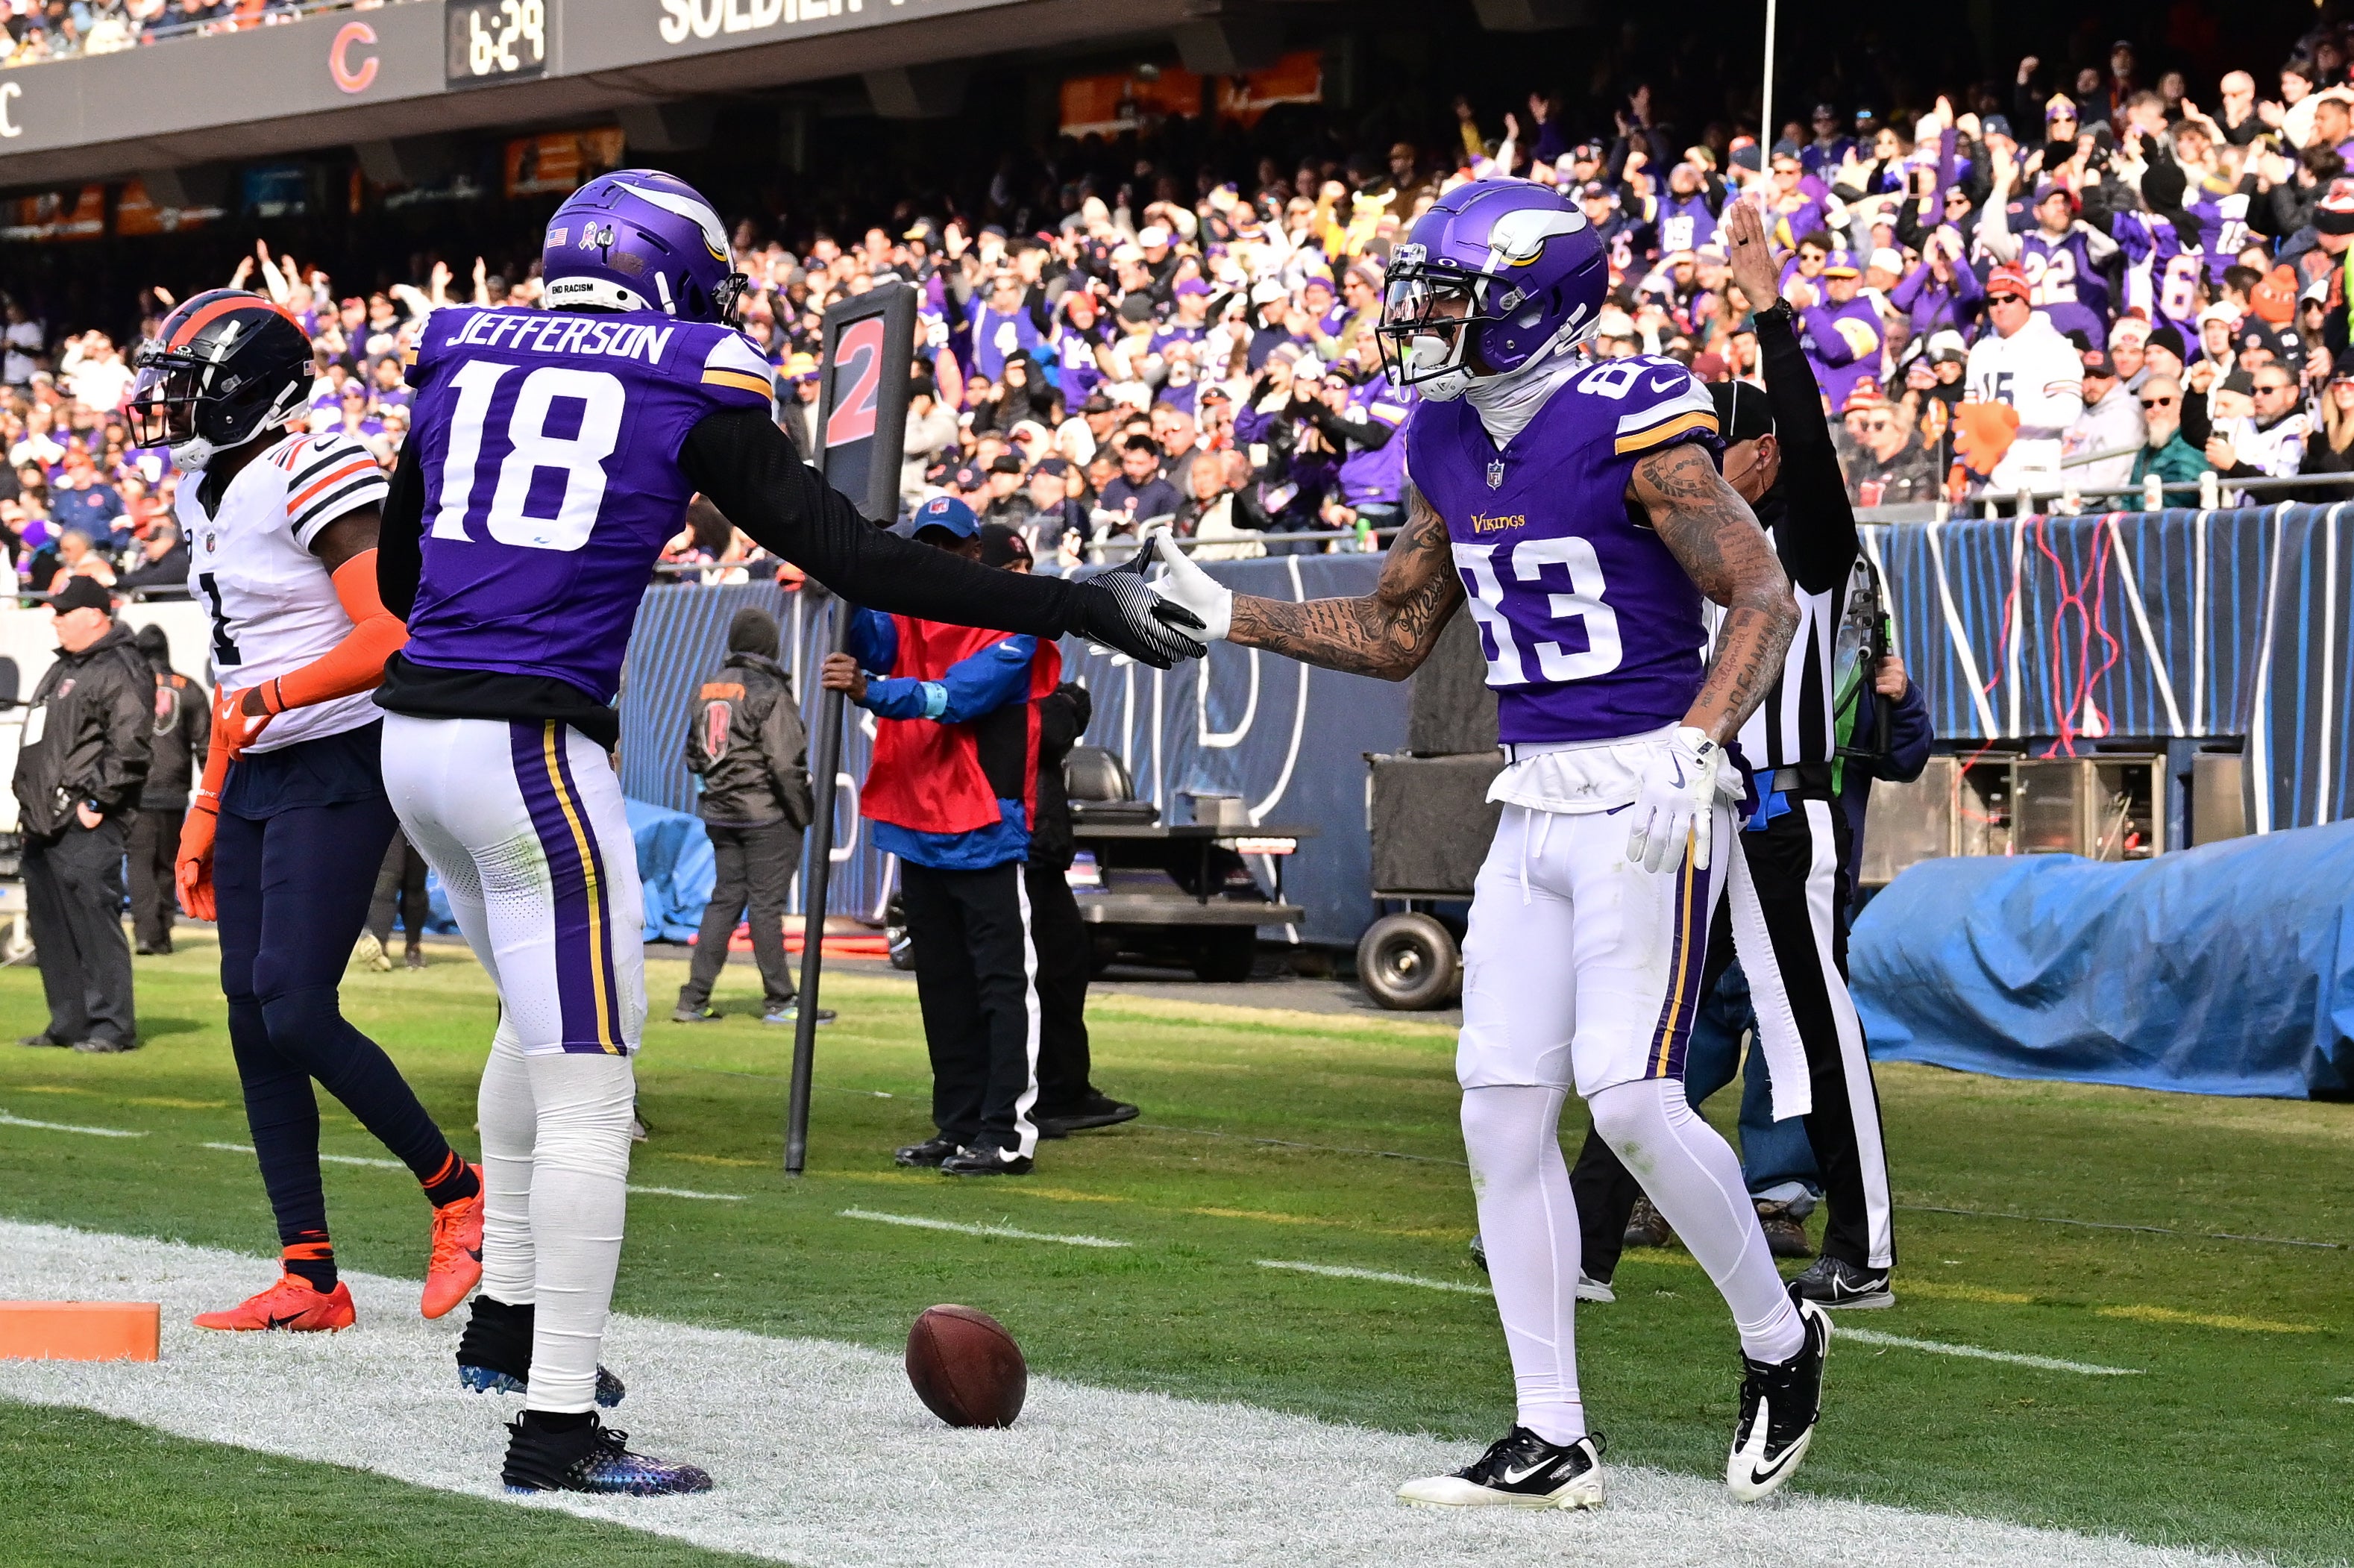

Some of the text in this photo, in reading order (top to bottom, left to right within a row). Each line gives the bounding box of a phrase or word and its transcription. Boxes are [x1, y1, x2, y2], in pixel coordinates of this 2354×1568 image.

[329, 21, 379, 94] C
[470, 0, 544, 75] 6:29
[659, 0, 863, 44] SOLD
[597, 231, 614, 245] KJ
[552, 283, 594, 295] END RACISM
[2024, 248, 2079, 307] 22
[445, 311, 675, 365] JEFFERSON
[826, 318, 885, 448] 2
[430, 359, 626, 551] 18
[198, 571, 242, 666] 1
[1451, 536, 1623, 686] 83
